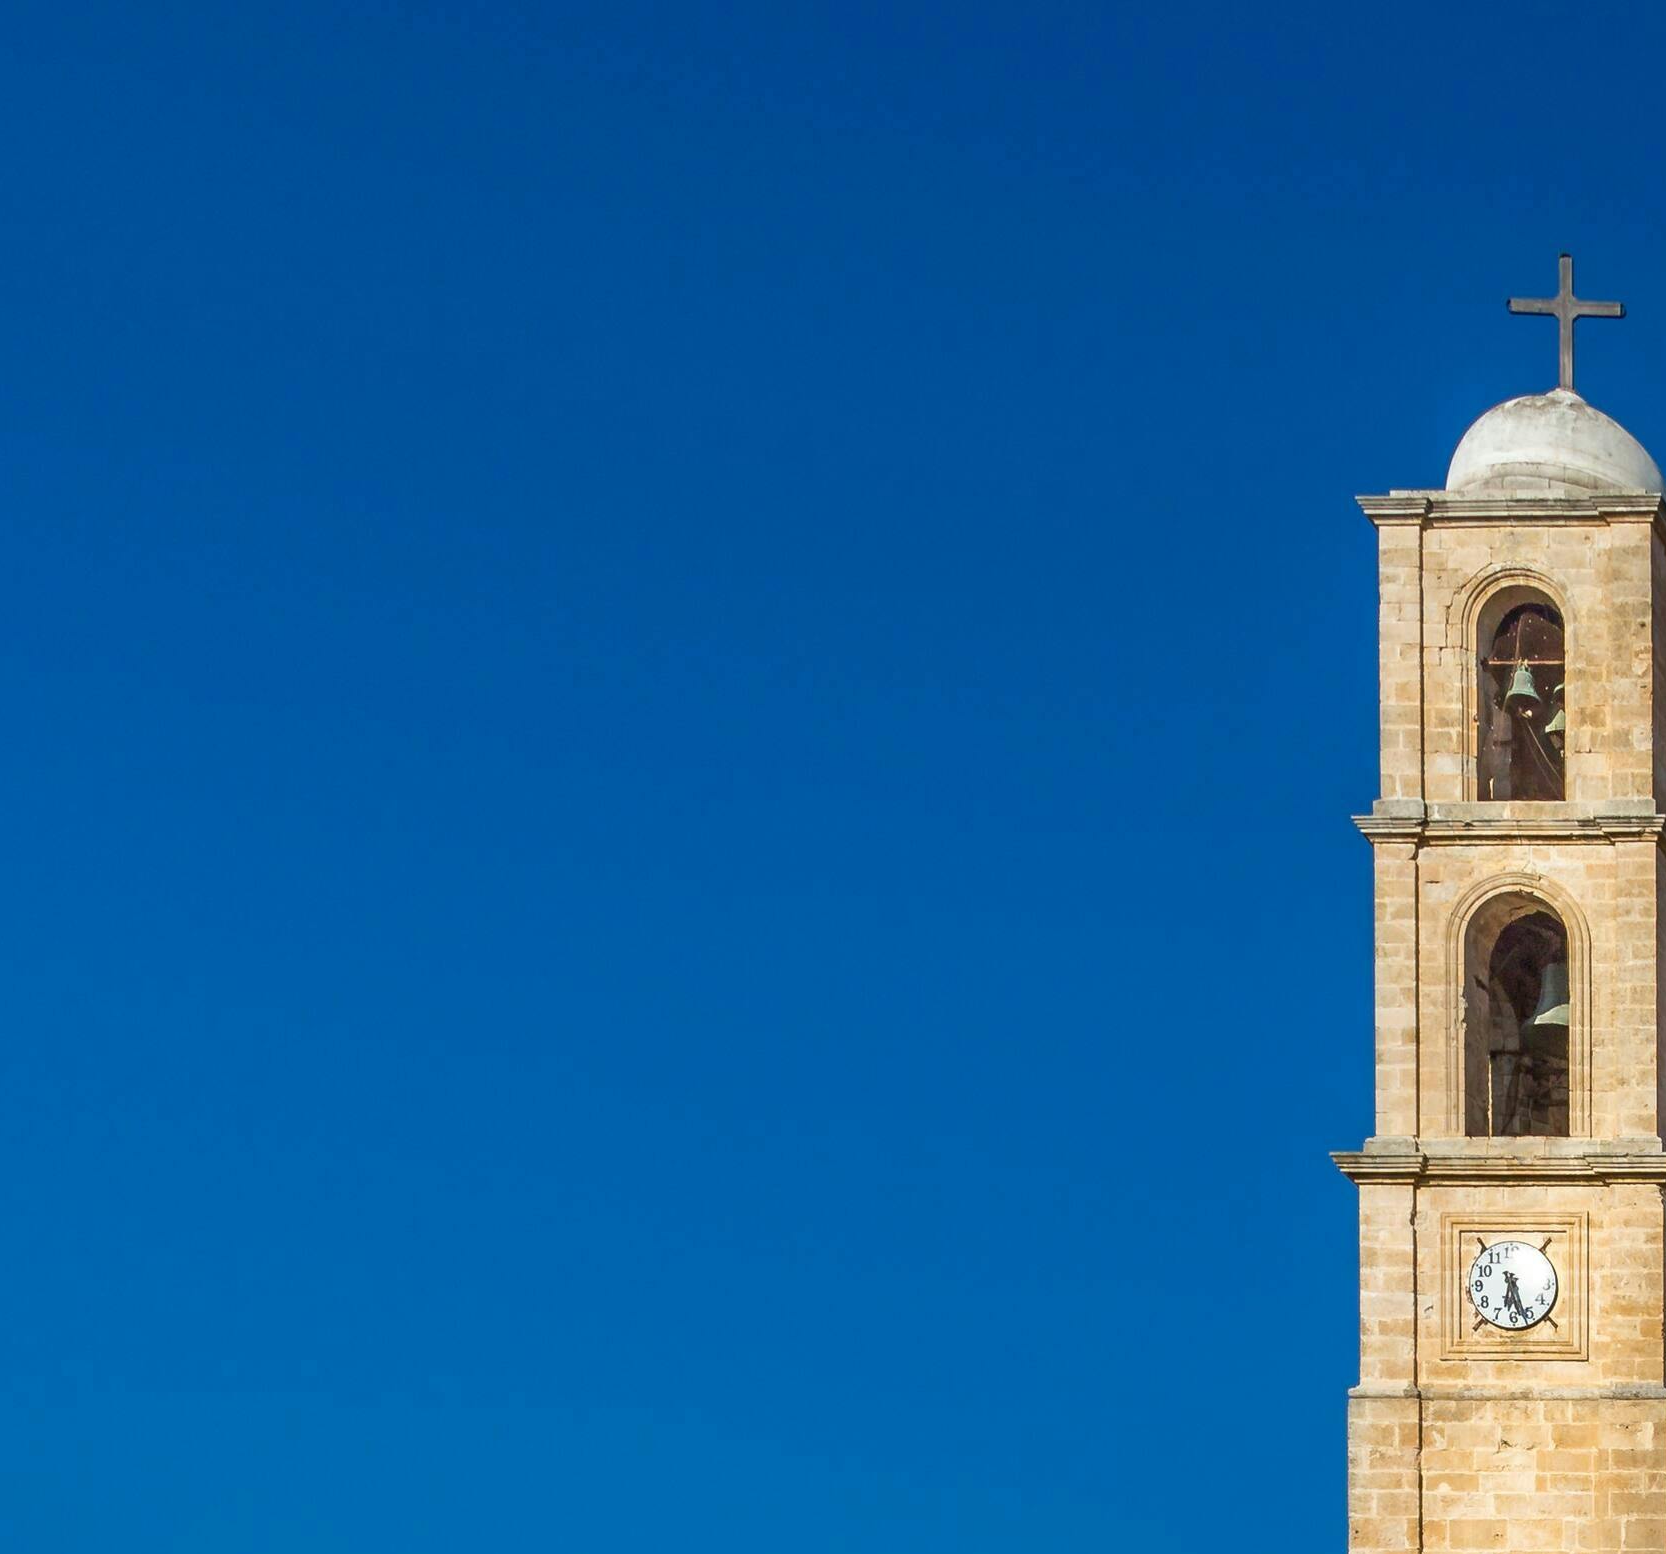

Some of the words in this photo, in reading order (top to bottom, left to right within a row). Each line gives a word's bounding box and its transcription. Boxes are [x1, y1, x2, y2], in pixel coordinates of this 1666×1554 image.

[1488, 1251, 1501, 1264] 11
[1478, 1264, 1492, 1277] 10
[1474, 1279, 1484, 1292] 9
[1542, 1278, 1551, 1291] 3
[1480, 1295, 1489, 1309] 8
[1535, 1292, 1546, 1306] 4
[1493, 1307, 1503, 1320] 7
[1509, 1311, 1518, 1324] 6
[1524, 1306, 1534, 1320] 5
